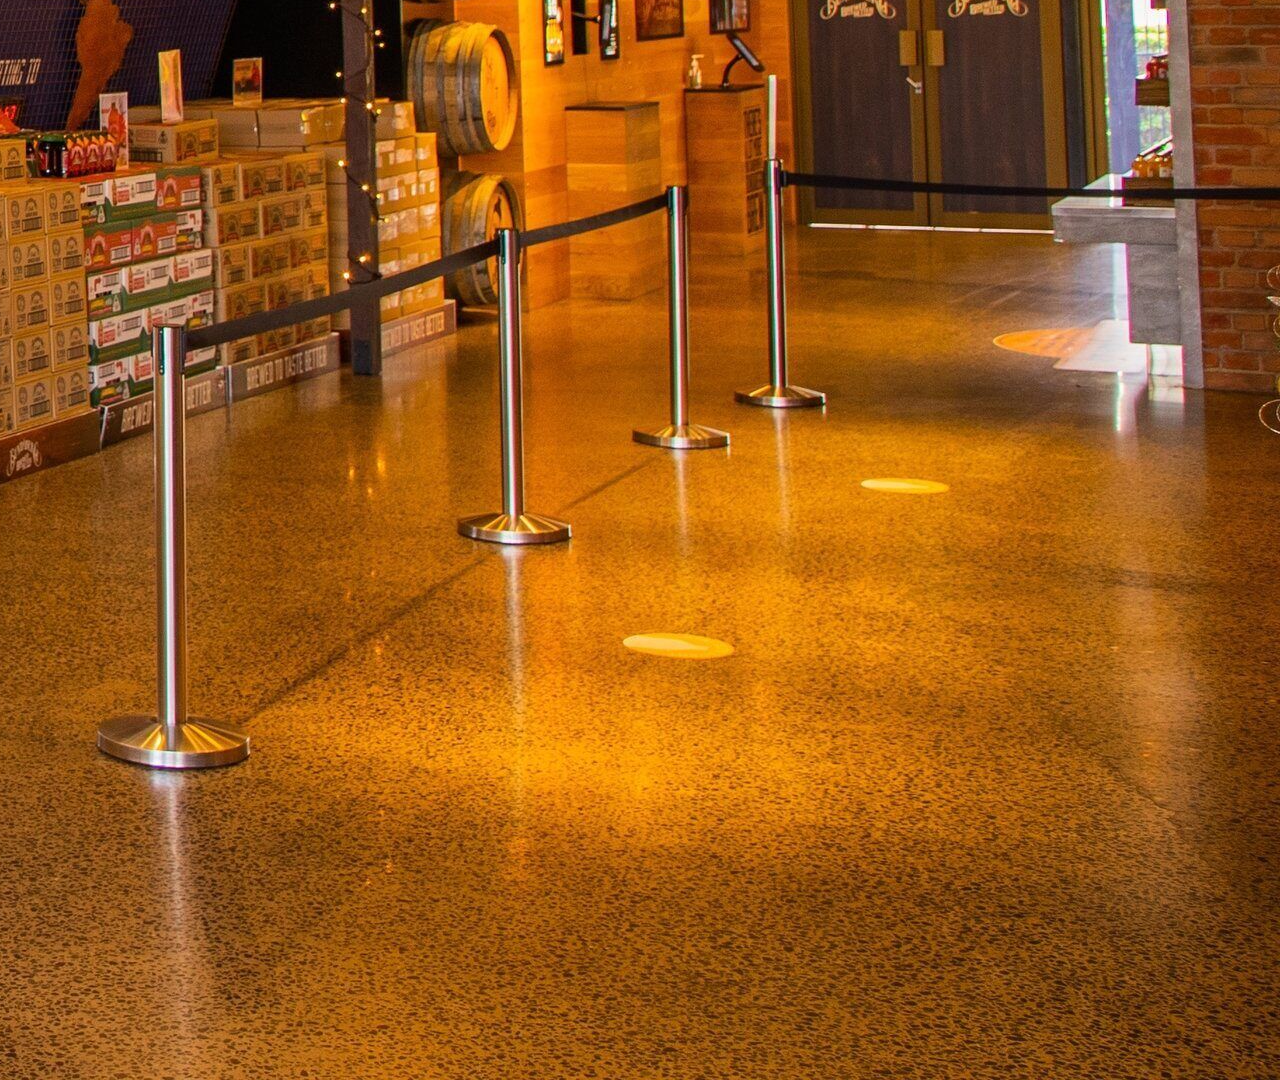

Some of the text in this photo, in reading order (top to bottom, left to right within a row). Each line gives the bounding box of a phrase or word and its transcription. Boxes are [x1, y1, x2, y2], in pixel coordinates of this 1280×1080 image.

[26, 58, 42, 84] TO
[247, 361, 273, 390] BREWED
[284, 352, 304, 378] TASTE
[305, 345, 327, 371] BETTER
